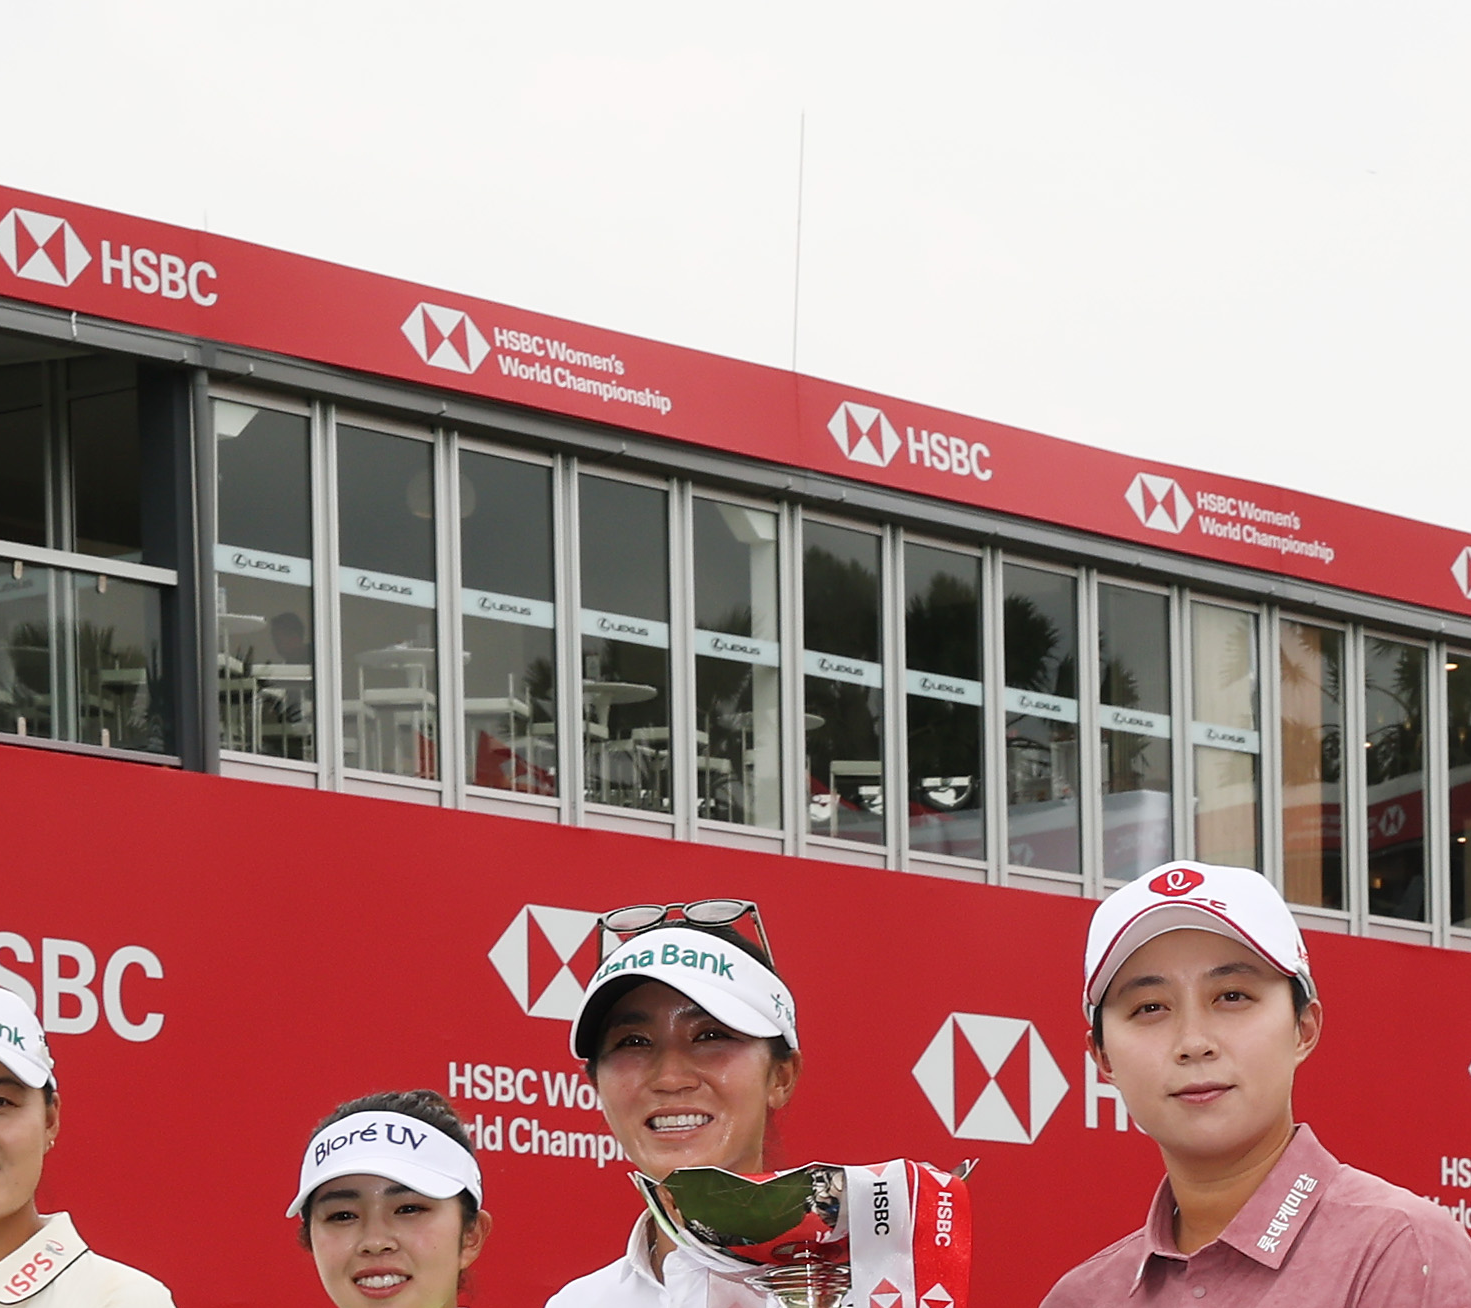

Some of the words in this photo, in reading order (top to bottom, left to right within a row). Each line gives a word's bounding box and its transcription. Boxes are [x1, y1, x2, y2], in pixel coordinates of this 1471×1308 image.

[101, 240, 218, 306] HSBC
[494, 326, 544, 357] HSBC
[546, 340, 625, 375] Women's
[497, 354, 553, 385] World
[554, 368, 672, 414] Championship
[906, 427, 993, 481] HSBC
[1197, 491, 1237, 516] HSBC
[1238, 502, 1301, 530] Women's
[1199, 515, 1241, 540] World
[1242, 528, 1336, 564] Championship
[248, 559, 291, 573] LEXUS
[372, 583, 413, 595] LEXUS
[492, 602, 531, 616] LEXUS
[611, 624, 649, 636] LEXUS
[724, 644, 761, 655] LEXUS
[830, 664, 864, 676] LEXUS
[932, 684, 965, 695] LEXUS
[661, 944, 735, 980] Bank
[448, 1061, 539, 1106] HSBC
[385, 1123, 428, 1150] UV
[873, 1182, 890, 1236] HSBC
[935, 1191, 953, 1247] HSBC
[1256, 1174, 1318, 1254] 롯데케미칼
[5, 1252, 53, 1297] ISPS
